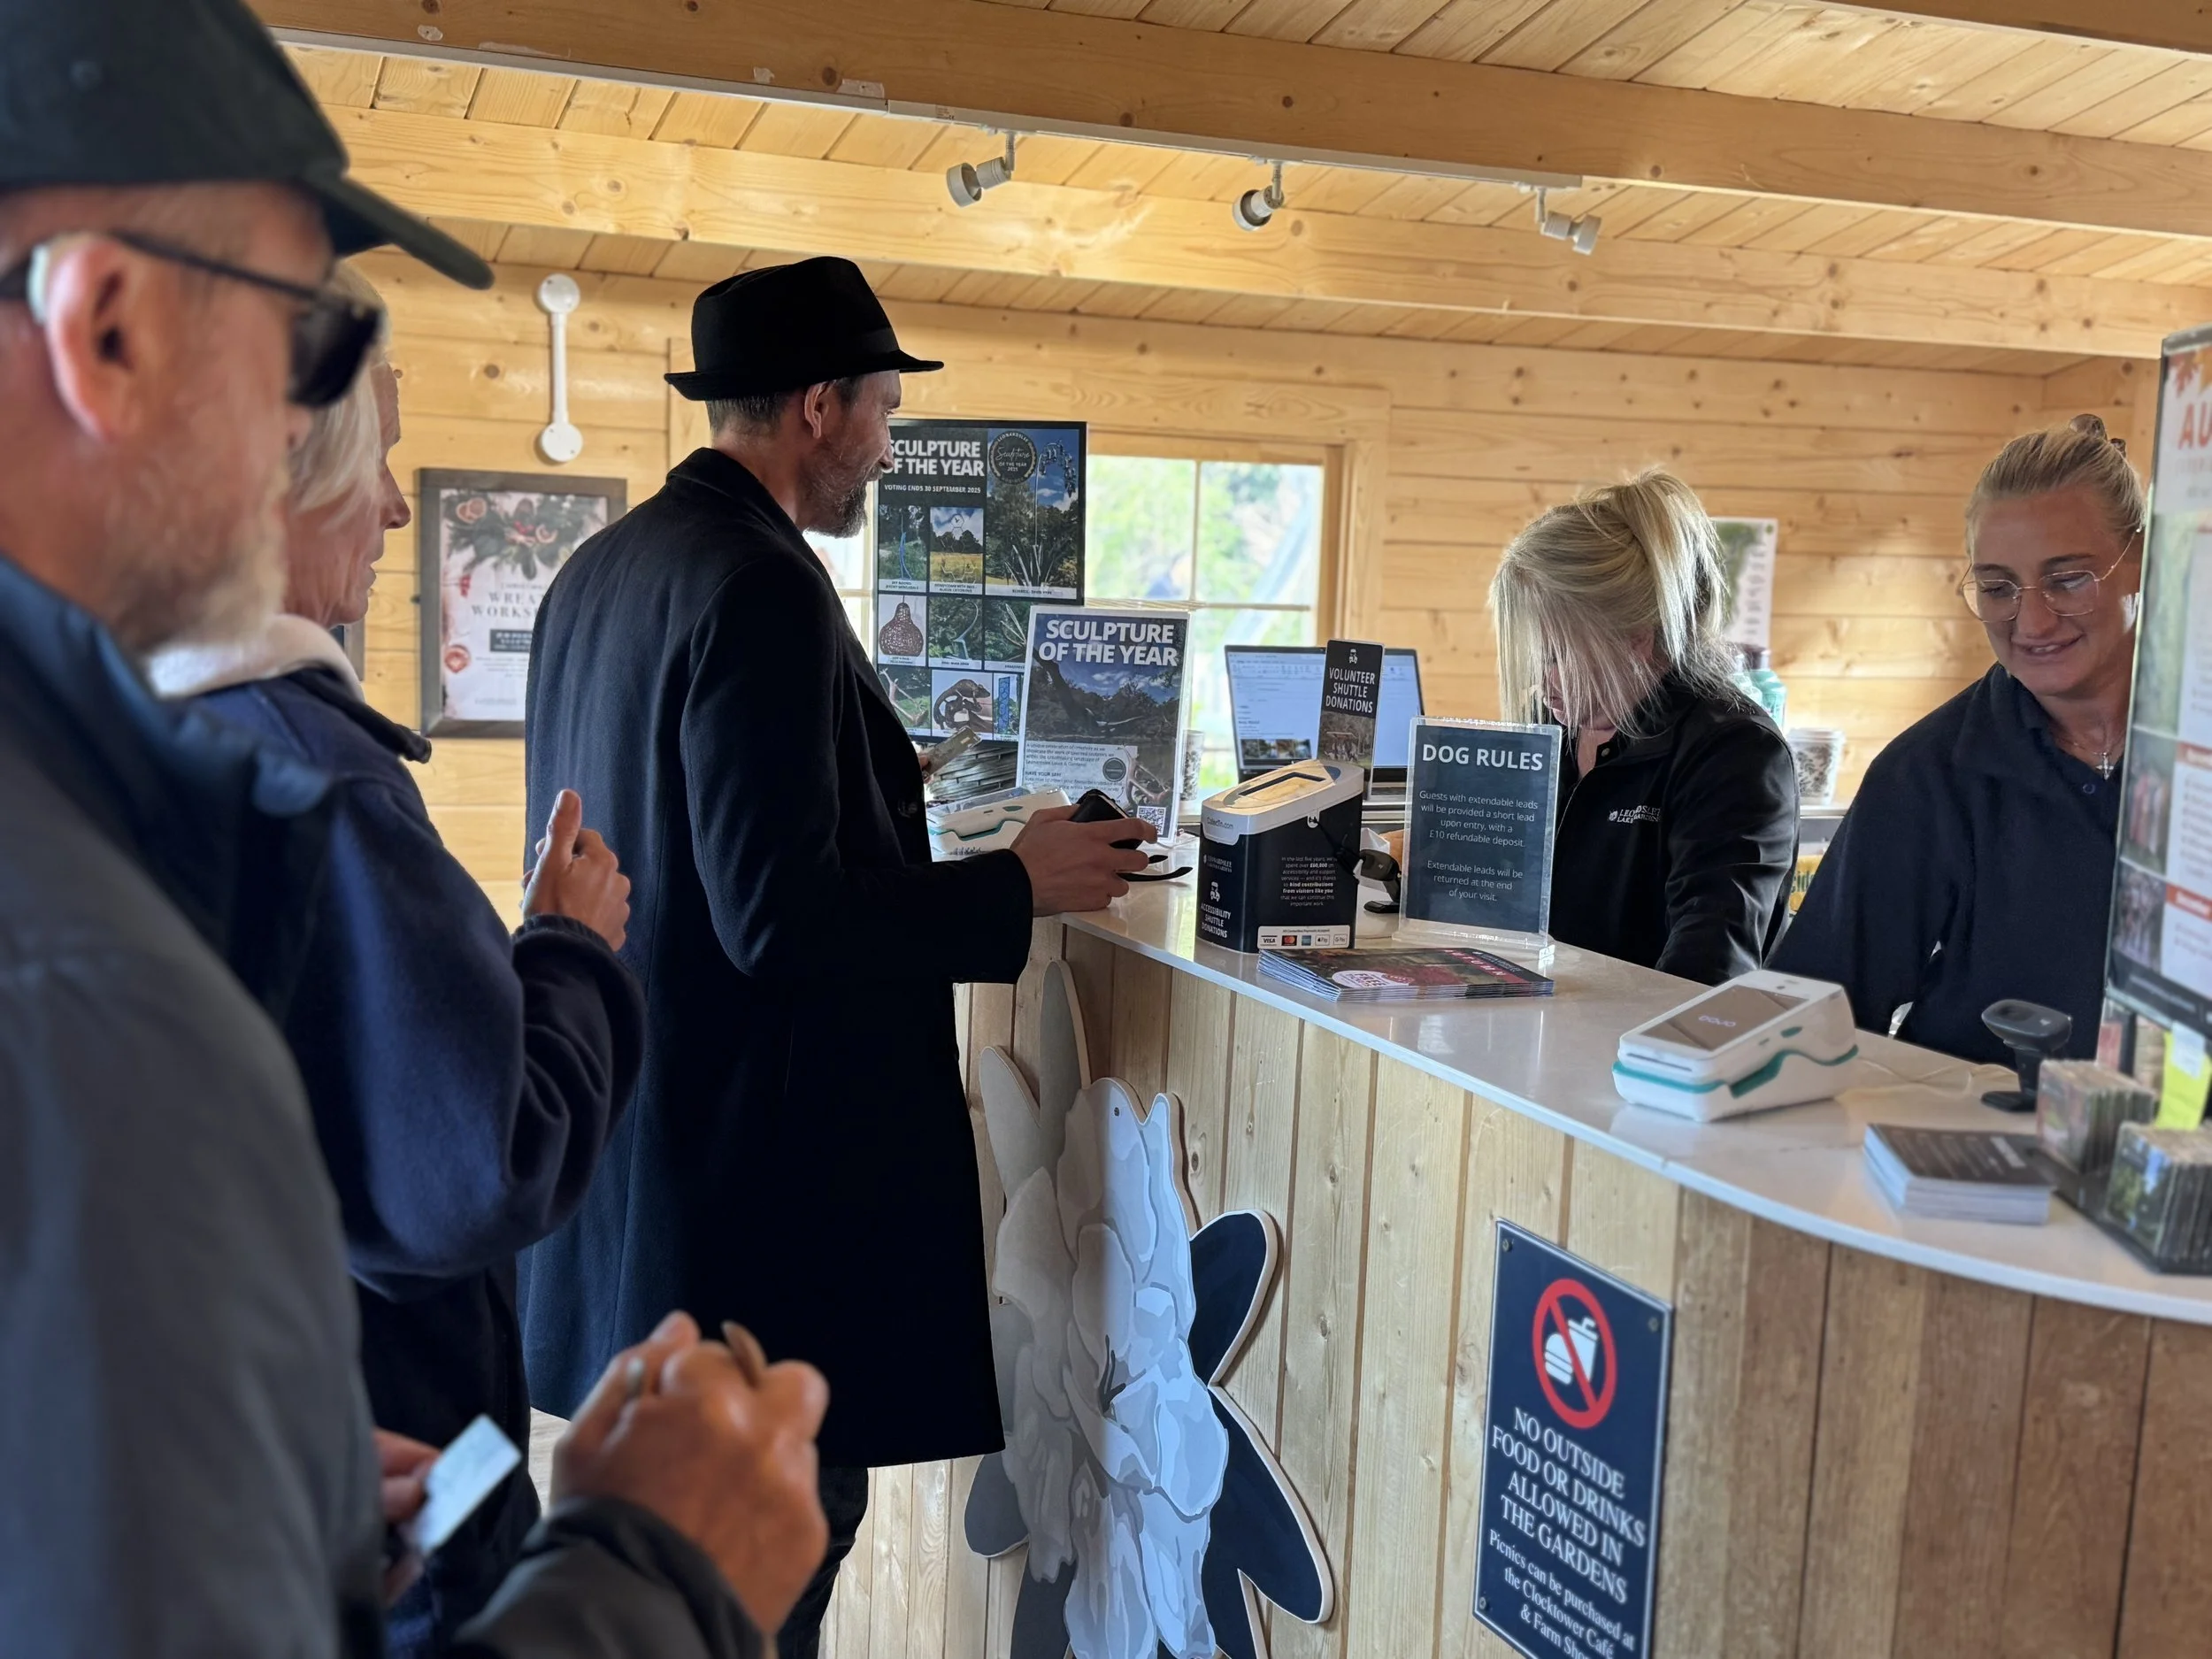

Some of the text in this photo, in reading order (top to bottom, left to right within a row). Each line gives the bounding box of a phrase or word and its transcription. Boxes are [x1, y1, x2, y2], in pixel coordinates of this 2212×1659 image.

[905, 458, 937, 474] THE
[941, 460, 985, 476] YEAR
[488, 592, 545, 605] WREA
[1046, 619, 1175, 643] SCULPTURE
[1039, 641, 1178, 666] OF THE YEAR
[1329, 667, 1375, 685] VOLUNTEER
[1333, 682, 1368, 698] SHUTTLE
[1325, 695, 1372, 713] DONATIONS
[1423, 744, 1543, 771] DOG RULES
[1419, 790, 1448, 801] Guests
[1469, 796, 1514, 807] extendable
[1516, 800, 1538, 810] leads
[1448, 807, 1484, 817] provided
[1494, 811, 1514, 820] short
[1447, 832, 1490, 843] refundable
[1427, 860, 1472, 872] Extendable
[1474, 865, 1495, 875] leads
[1433, 875, 1469, 885] returned
[1481, 879, 1494, 888] the
[1459, 890, 1477, 899] your
[1201, 902, 1231, 919] ACCESSIBILITY
[1205, 914, 1224, 927] SHUTTLE
[1202, 922, 1227, 938] DONATIONS
[1514, 1407, 1625, 1499] NO OUTSIDE
[1492, 1425, 1646, 1548] FOOD OR DRINKS
[1508, 1471, 1624, 1567] ALLOWED IN
[1501, 1494, 1627, 1603] THE GARDENS
[1489, 1529, 1634, 1651] Picnics can be purchased at
[1503, 1566, 1614, 1659] the Clocktower Café
[1521, 1604, 1592, 1659] & Farm Sho
